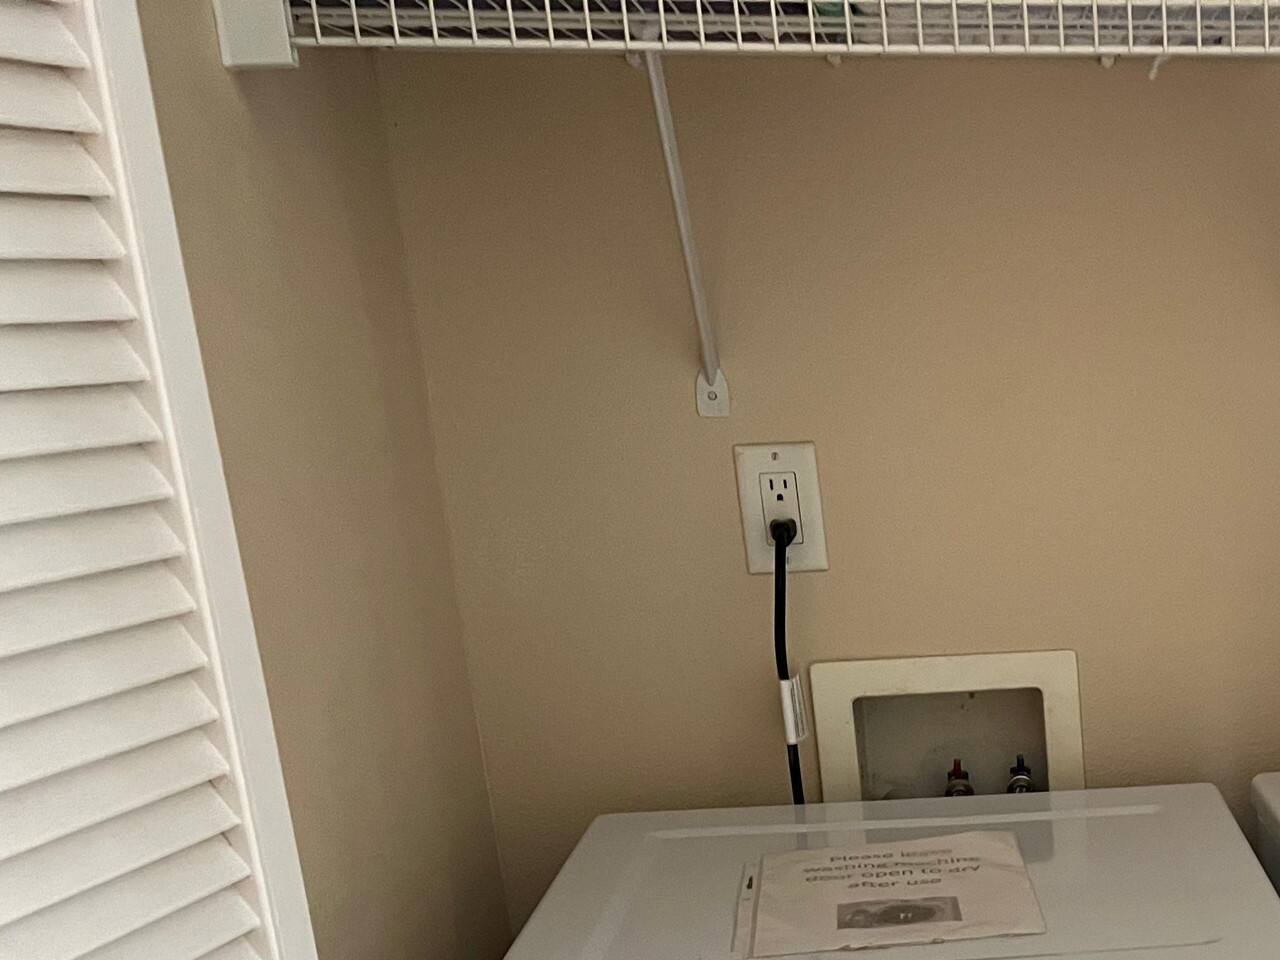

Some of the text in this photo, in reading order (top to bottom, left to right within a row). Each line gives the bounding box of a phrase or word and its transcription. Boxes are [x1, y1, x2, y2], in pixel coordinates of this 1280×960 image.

[830, 853, 894, 862] Please
[803, 862, 891, 872] washing
[805, 874, 852, 882] door
[862, 870, 913, 879] open
[948, 865, 980, 874] dry
[907, 878, 942, 886] use
